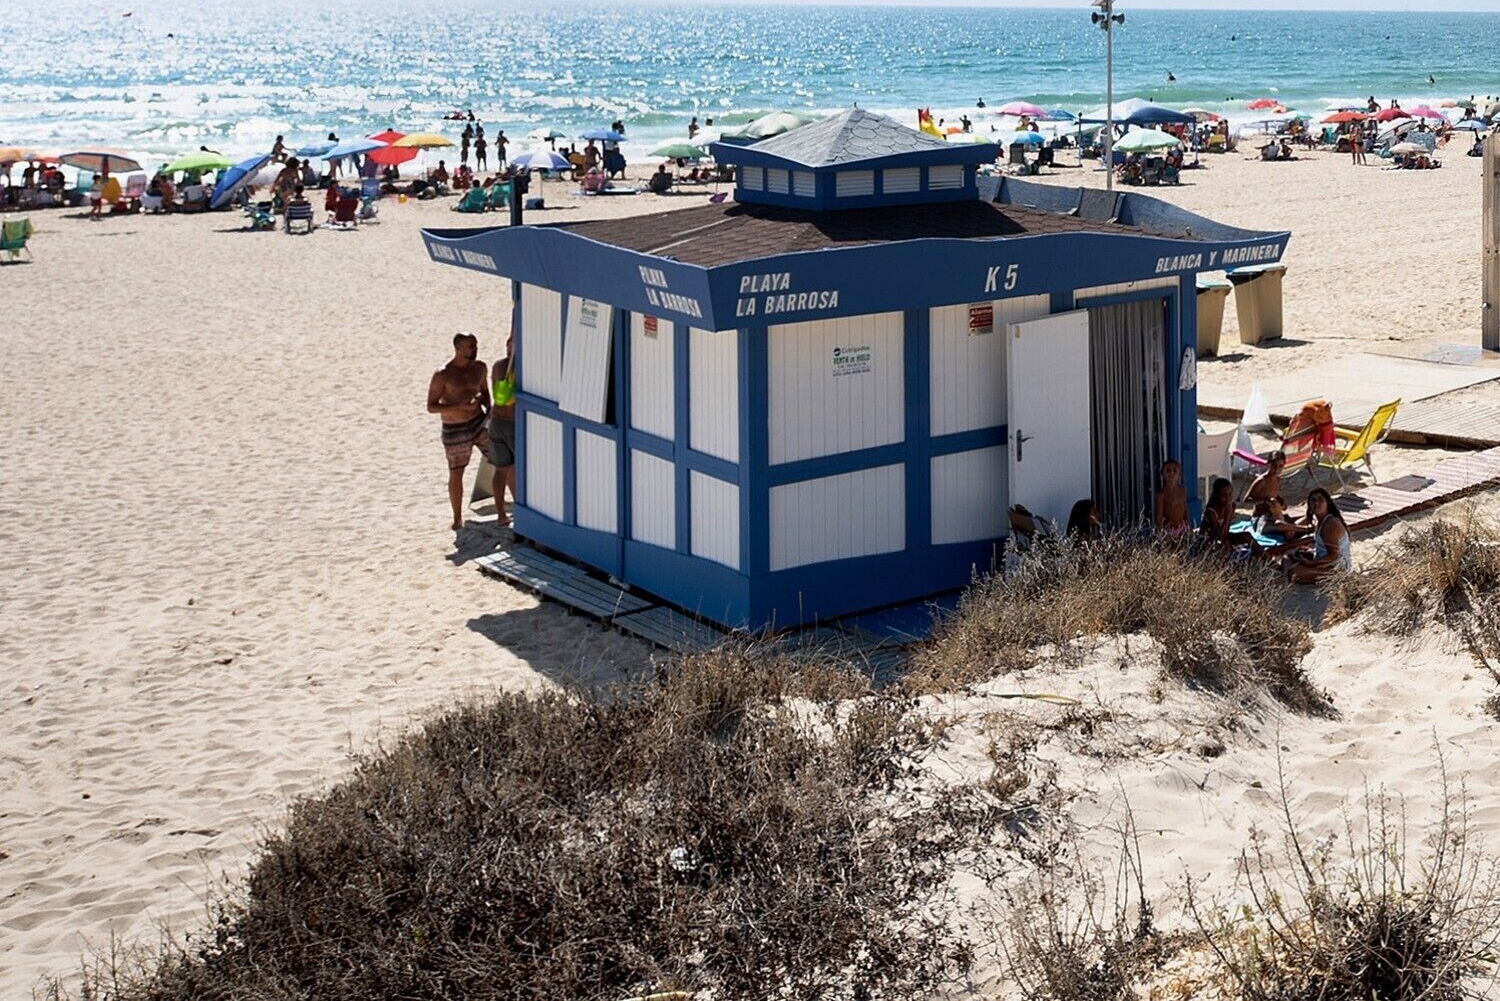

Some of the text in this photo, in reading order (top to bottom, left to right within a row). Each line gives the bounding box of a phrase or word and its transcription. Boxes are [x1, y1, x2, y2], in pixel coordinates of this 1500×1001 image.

[1155, 244, 1280, 273] BLANCA Y MARINERA
[638, 265, 668, 288] PLAYA
[740, 272, 790, 293] PLAYA
[984, 264, 1019, 293] K 5
[645, 287, 702, 318] LA BARROSA
[736, 290, 839, 317] LA BARROSA
